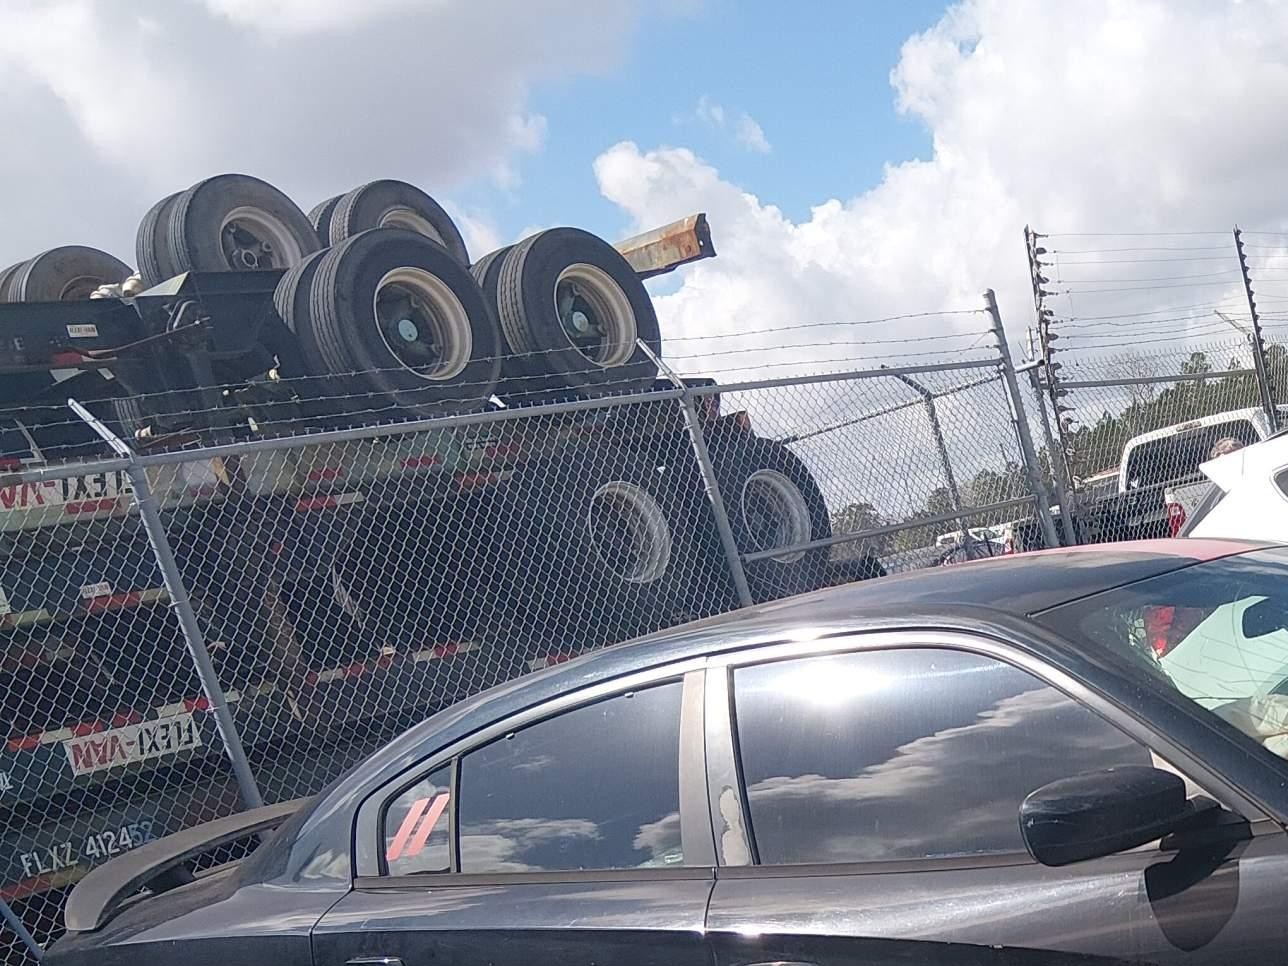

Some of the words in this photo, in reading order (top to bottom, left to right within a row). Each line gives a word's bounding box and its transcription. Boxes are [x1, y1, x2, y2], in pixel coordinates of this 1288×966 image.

[71, 721, 194, 769] FLEXI-VAN
[20, 842, 78, 877] FLXZ
[85, 821, 153, 858] 412452
